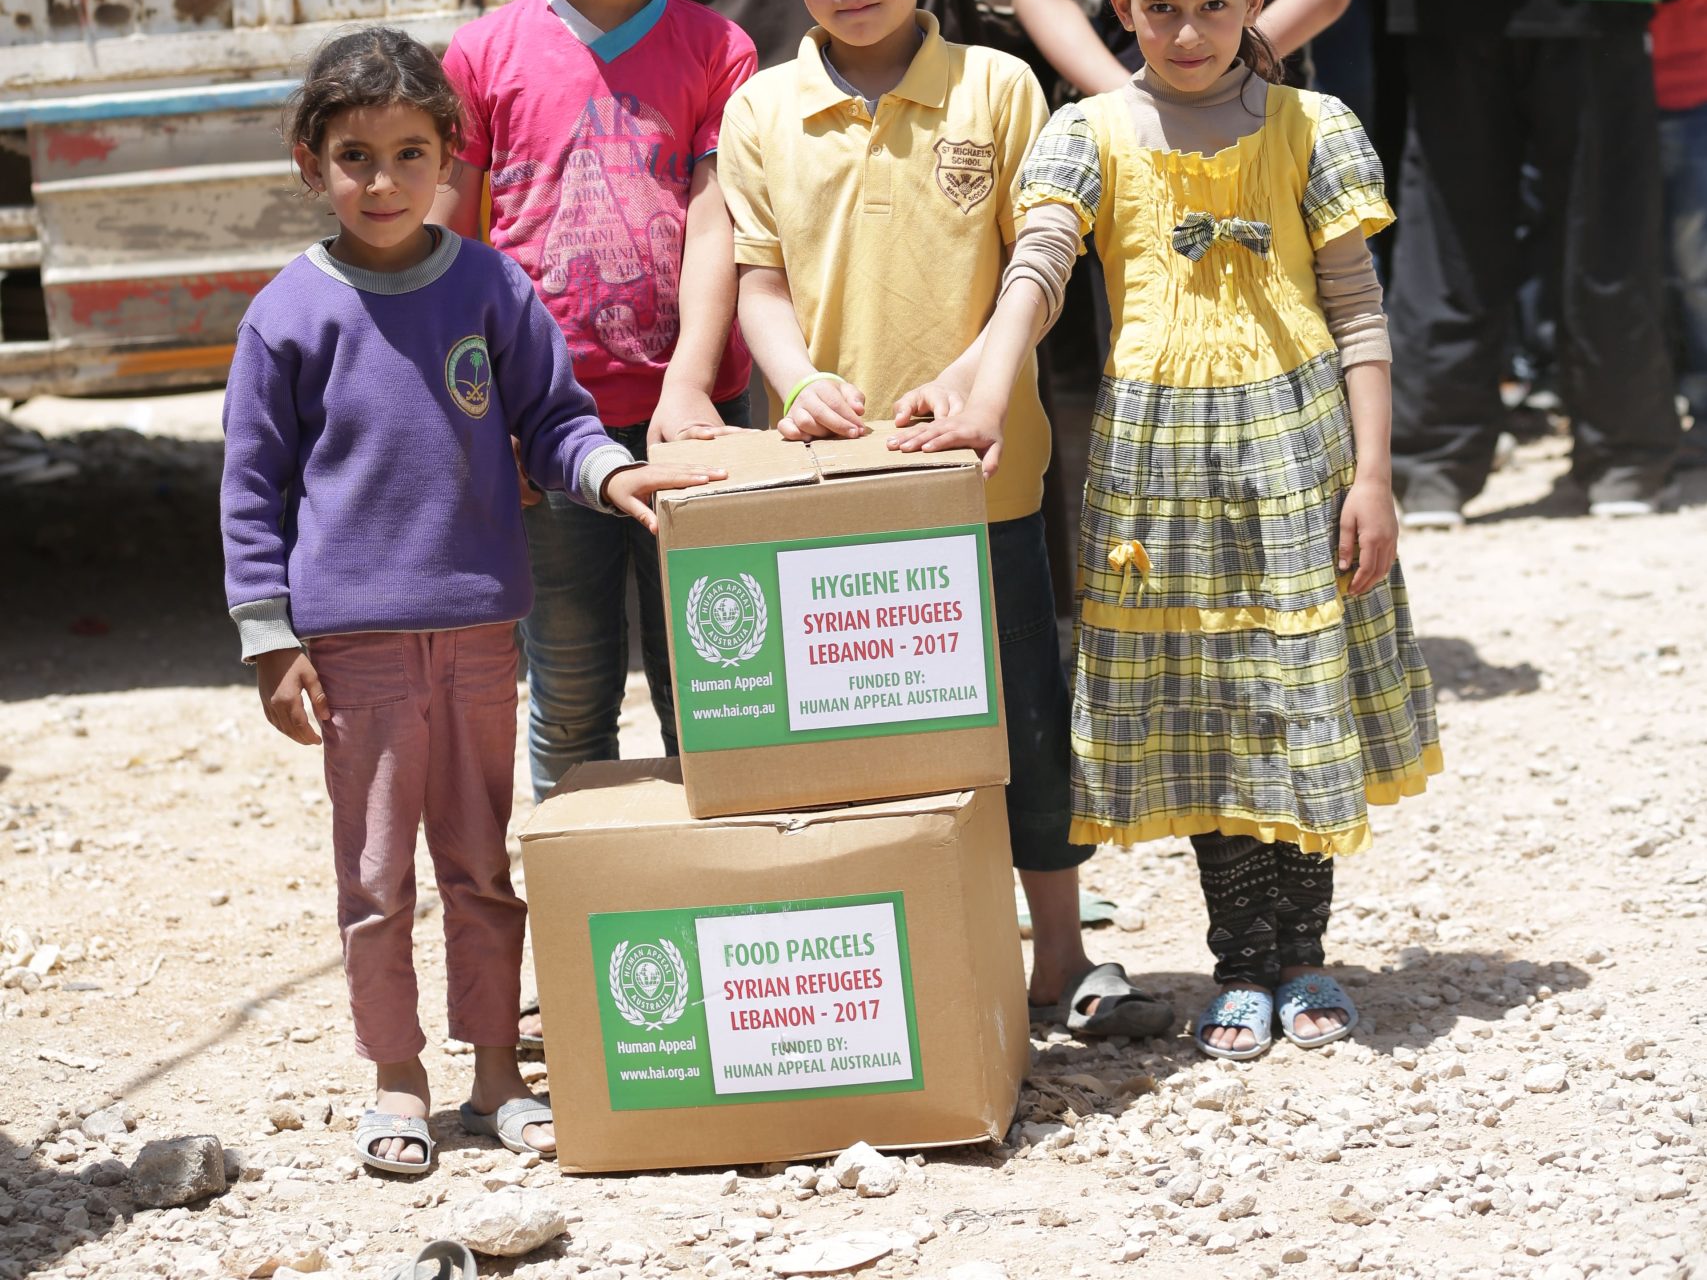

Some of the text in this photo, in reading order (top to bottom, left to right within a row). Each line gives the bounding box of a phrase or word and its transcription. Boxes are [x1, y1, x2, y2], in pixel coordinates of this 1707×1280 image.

[951, 156, 982, 167] SCHOOL
[952, 147, 992, 158] MICHAEL'S
[557, 229, 614, 247] ARMANI
[811, 565, 951, 600] HYGIENE KITS
[702, 583, 751, 614] HUMAN APPEAL
[803, 601, 963, 635] SYRIAN REFUGEES
[707, 628, 749, 647] AUSTRALIA
[808, 638, 895, 666] LEBANON
[912, 632, 960, 657] 2017
[691, 671, 773, 693] Human Appeal
[848, 670, 926, 691] FUNDED BY:
[692, 703, 776, 720] www.hai.org.au
[799, 685, 978, 716] HUMAN APPEAL AUSTRALIA
[723, 932, 876, 968] FOOD PARCELS
[624, 948, 672, 978] HUMAN APPEAL
[723, 968, 883, 1001] SYRIAN REFUGEES
[630, 992, 671, 1011] AUSTRALIA
[730, 1005, 816, 1032] LEBANON
[834, 999, 881, 1024] 2017
[616, 1036, 697, 1055] Human Appeal
[771, 1036, 849, 1057] FUNDED BY:
[620, 1066, 701, 1081] www.hai.org.au
[723, 1051, 902, 1080] HUMAN APPEAL AUSTRALIA
